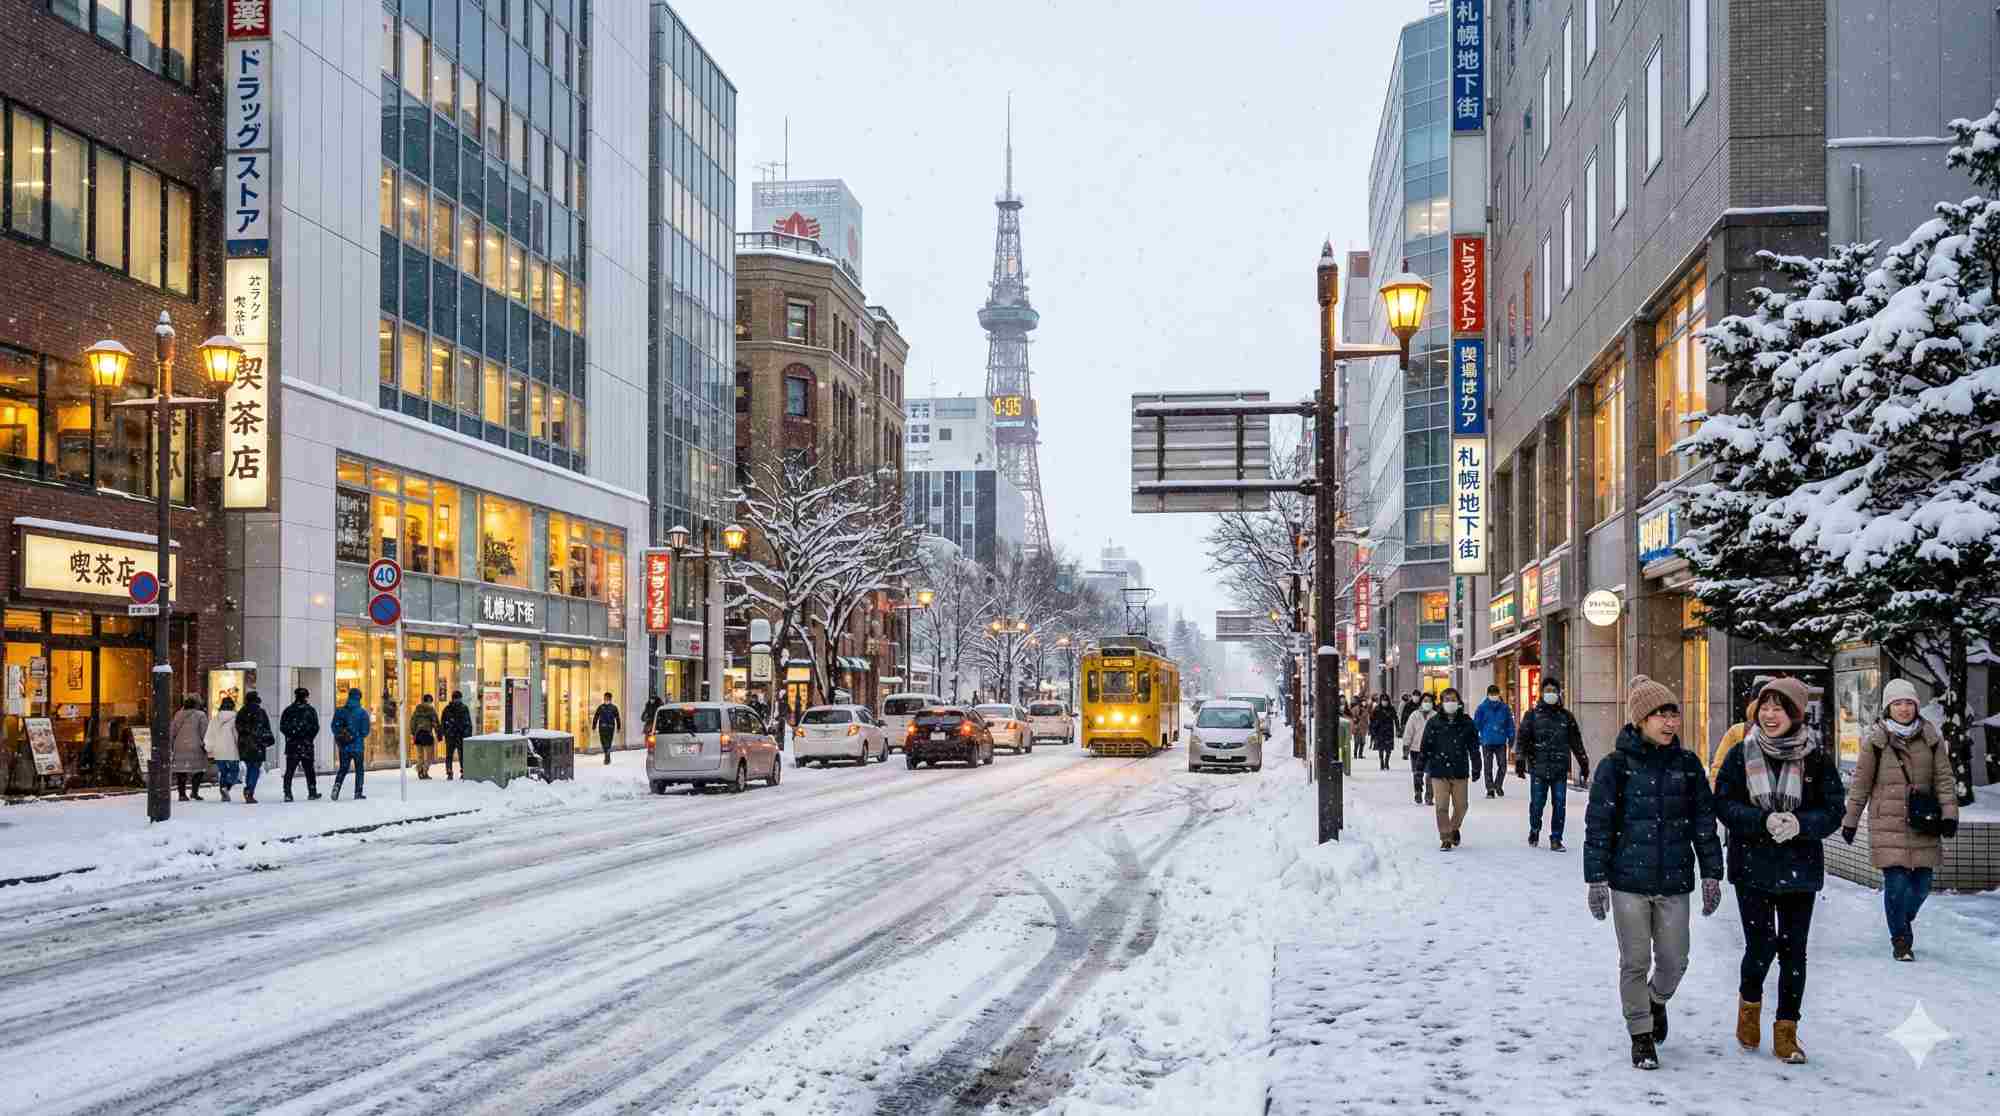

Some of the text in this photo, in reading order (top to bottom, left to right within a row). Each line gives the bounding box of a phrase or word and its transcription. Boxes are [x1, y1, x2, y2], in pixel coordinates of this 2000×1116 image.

[232, 0, 265, 30] 薬
[1456, 0, 1480, 119] 札幌地下街
[236, 49, 262, 233] ドラッグストア
[1457, 446, 1480, 559] 札幌地下街
[69, 550, 136, 587] 喫茶店
[375, 567, 396, 583] 40
[483, 595, 535, 625] 札幌地下街
